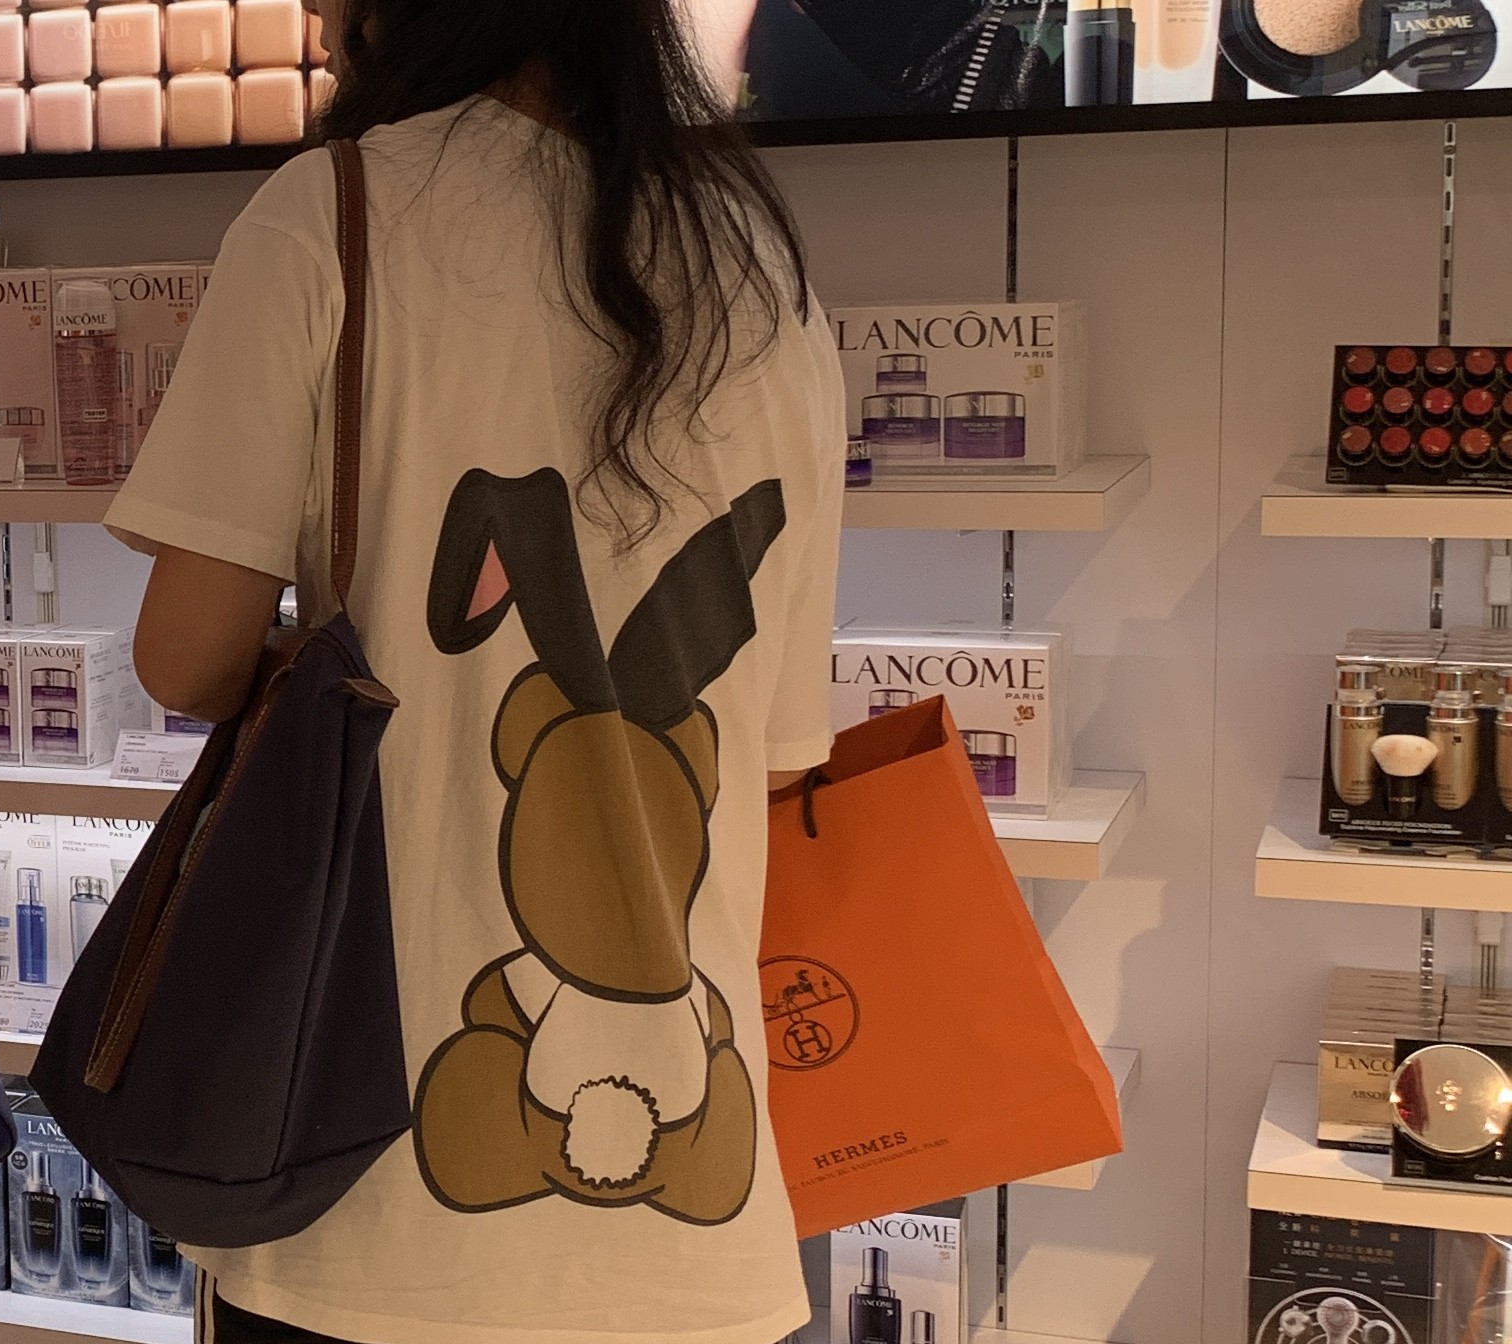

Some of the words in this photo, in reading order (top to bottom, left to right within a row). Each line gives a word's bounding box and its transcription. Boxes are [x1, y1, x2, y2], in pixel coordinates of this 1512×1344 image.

[113, 274, 193, 301] CÔME
[56, 313, 107, 326] LANCÔME
[837, 311, 1054, 351] LANCÔME
[830, 650, 1045, 690] LANCÔME
